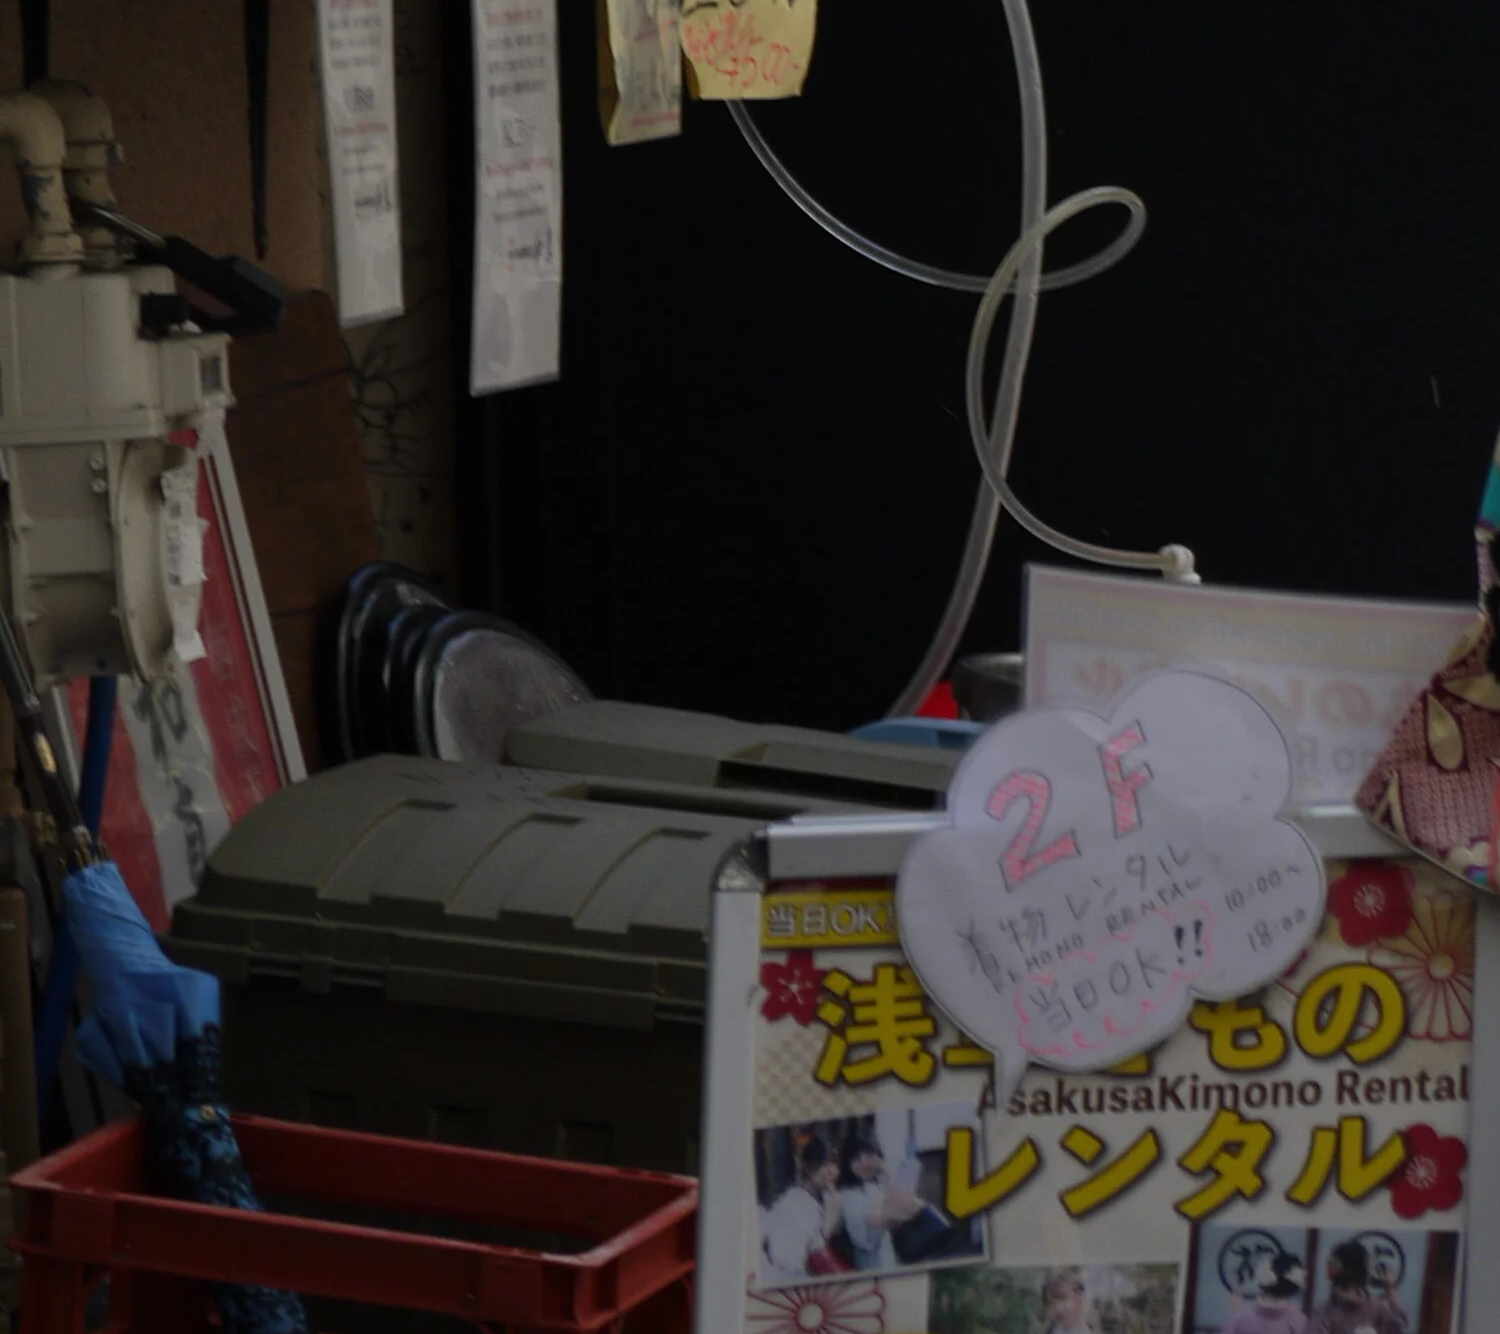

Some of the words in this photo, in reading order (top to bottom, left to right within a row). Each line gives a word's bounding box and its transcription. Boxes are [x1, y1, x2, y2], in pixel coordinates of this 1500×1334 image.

[985, 719, 1154, 896] 2F
[1336, 1068, 1469, 1107] Rental
[944, 1106, 1406, 1222] レンタル
